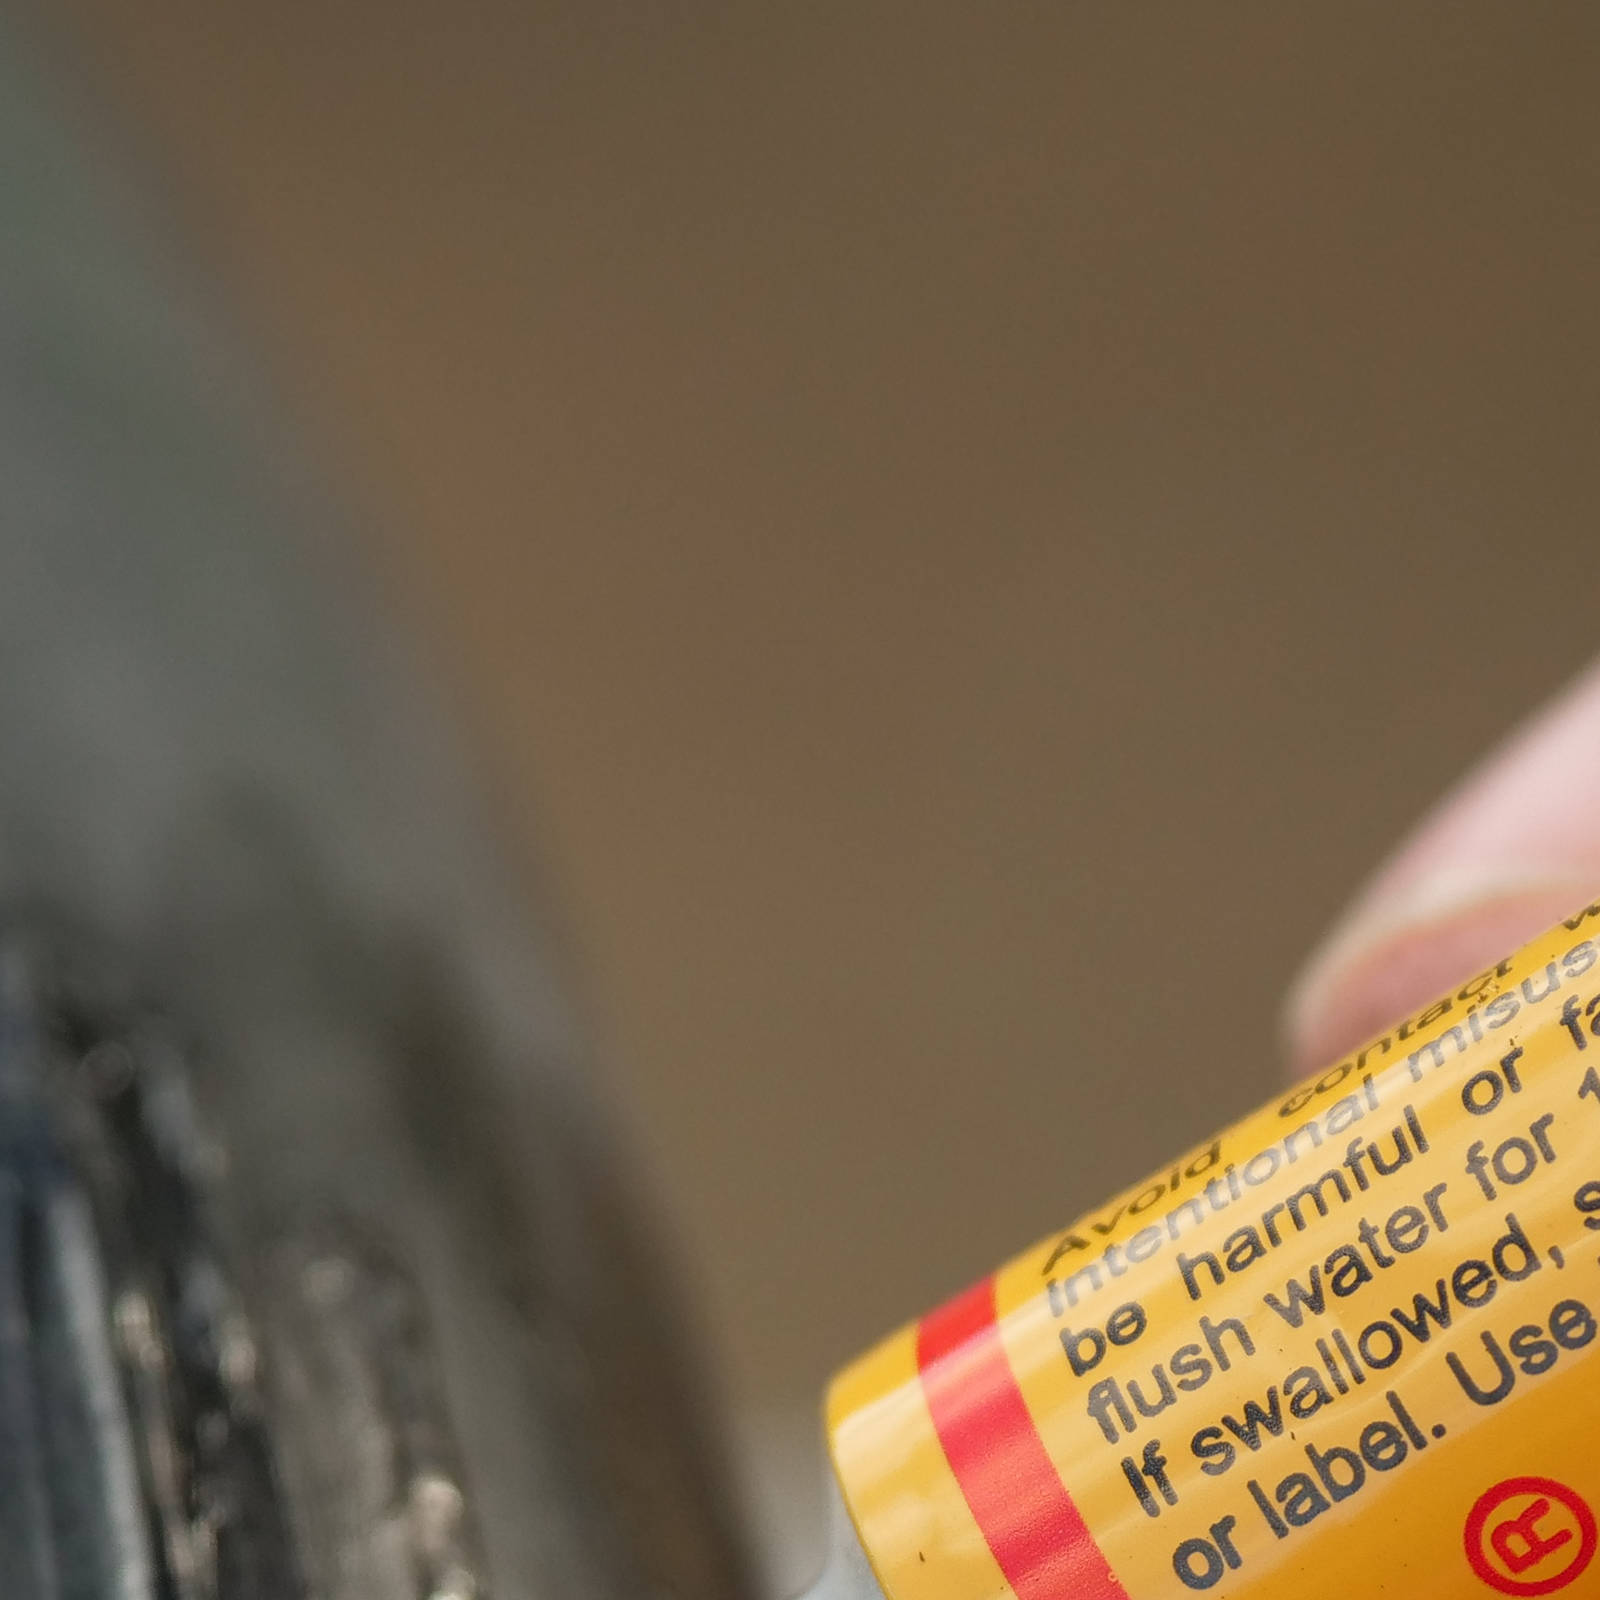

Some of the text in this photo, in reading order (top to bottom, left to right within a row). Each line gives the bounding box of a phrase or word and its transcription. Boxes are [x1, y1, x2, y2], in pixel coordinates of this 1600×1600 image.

[1041, 1139, 1227, 1278] Avoid
[1278, 960, 1513, 1118] contact
[1044, 1076, 1378, 1316] Intentional
[1062, 1302, 1148, 1378] be
[1176, 1105, 1431, 1301] harmful
[1461, 1046, 1526, 1114] or
[1086, 1310, 1257, 1447] flush
[1264, 1181, 1450, 1335] water
[1466, 1111, 1560, 1201] for
[1120, 1438, 1176, 1519] If
[1190, 1213, 1565, 1477] swallowed,
[1171, 1515, 1245, 1591] or
[1248, 1391, 1447, 1541] label.
[1445, 1297, 1598, 1408] Use
